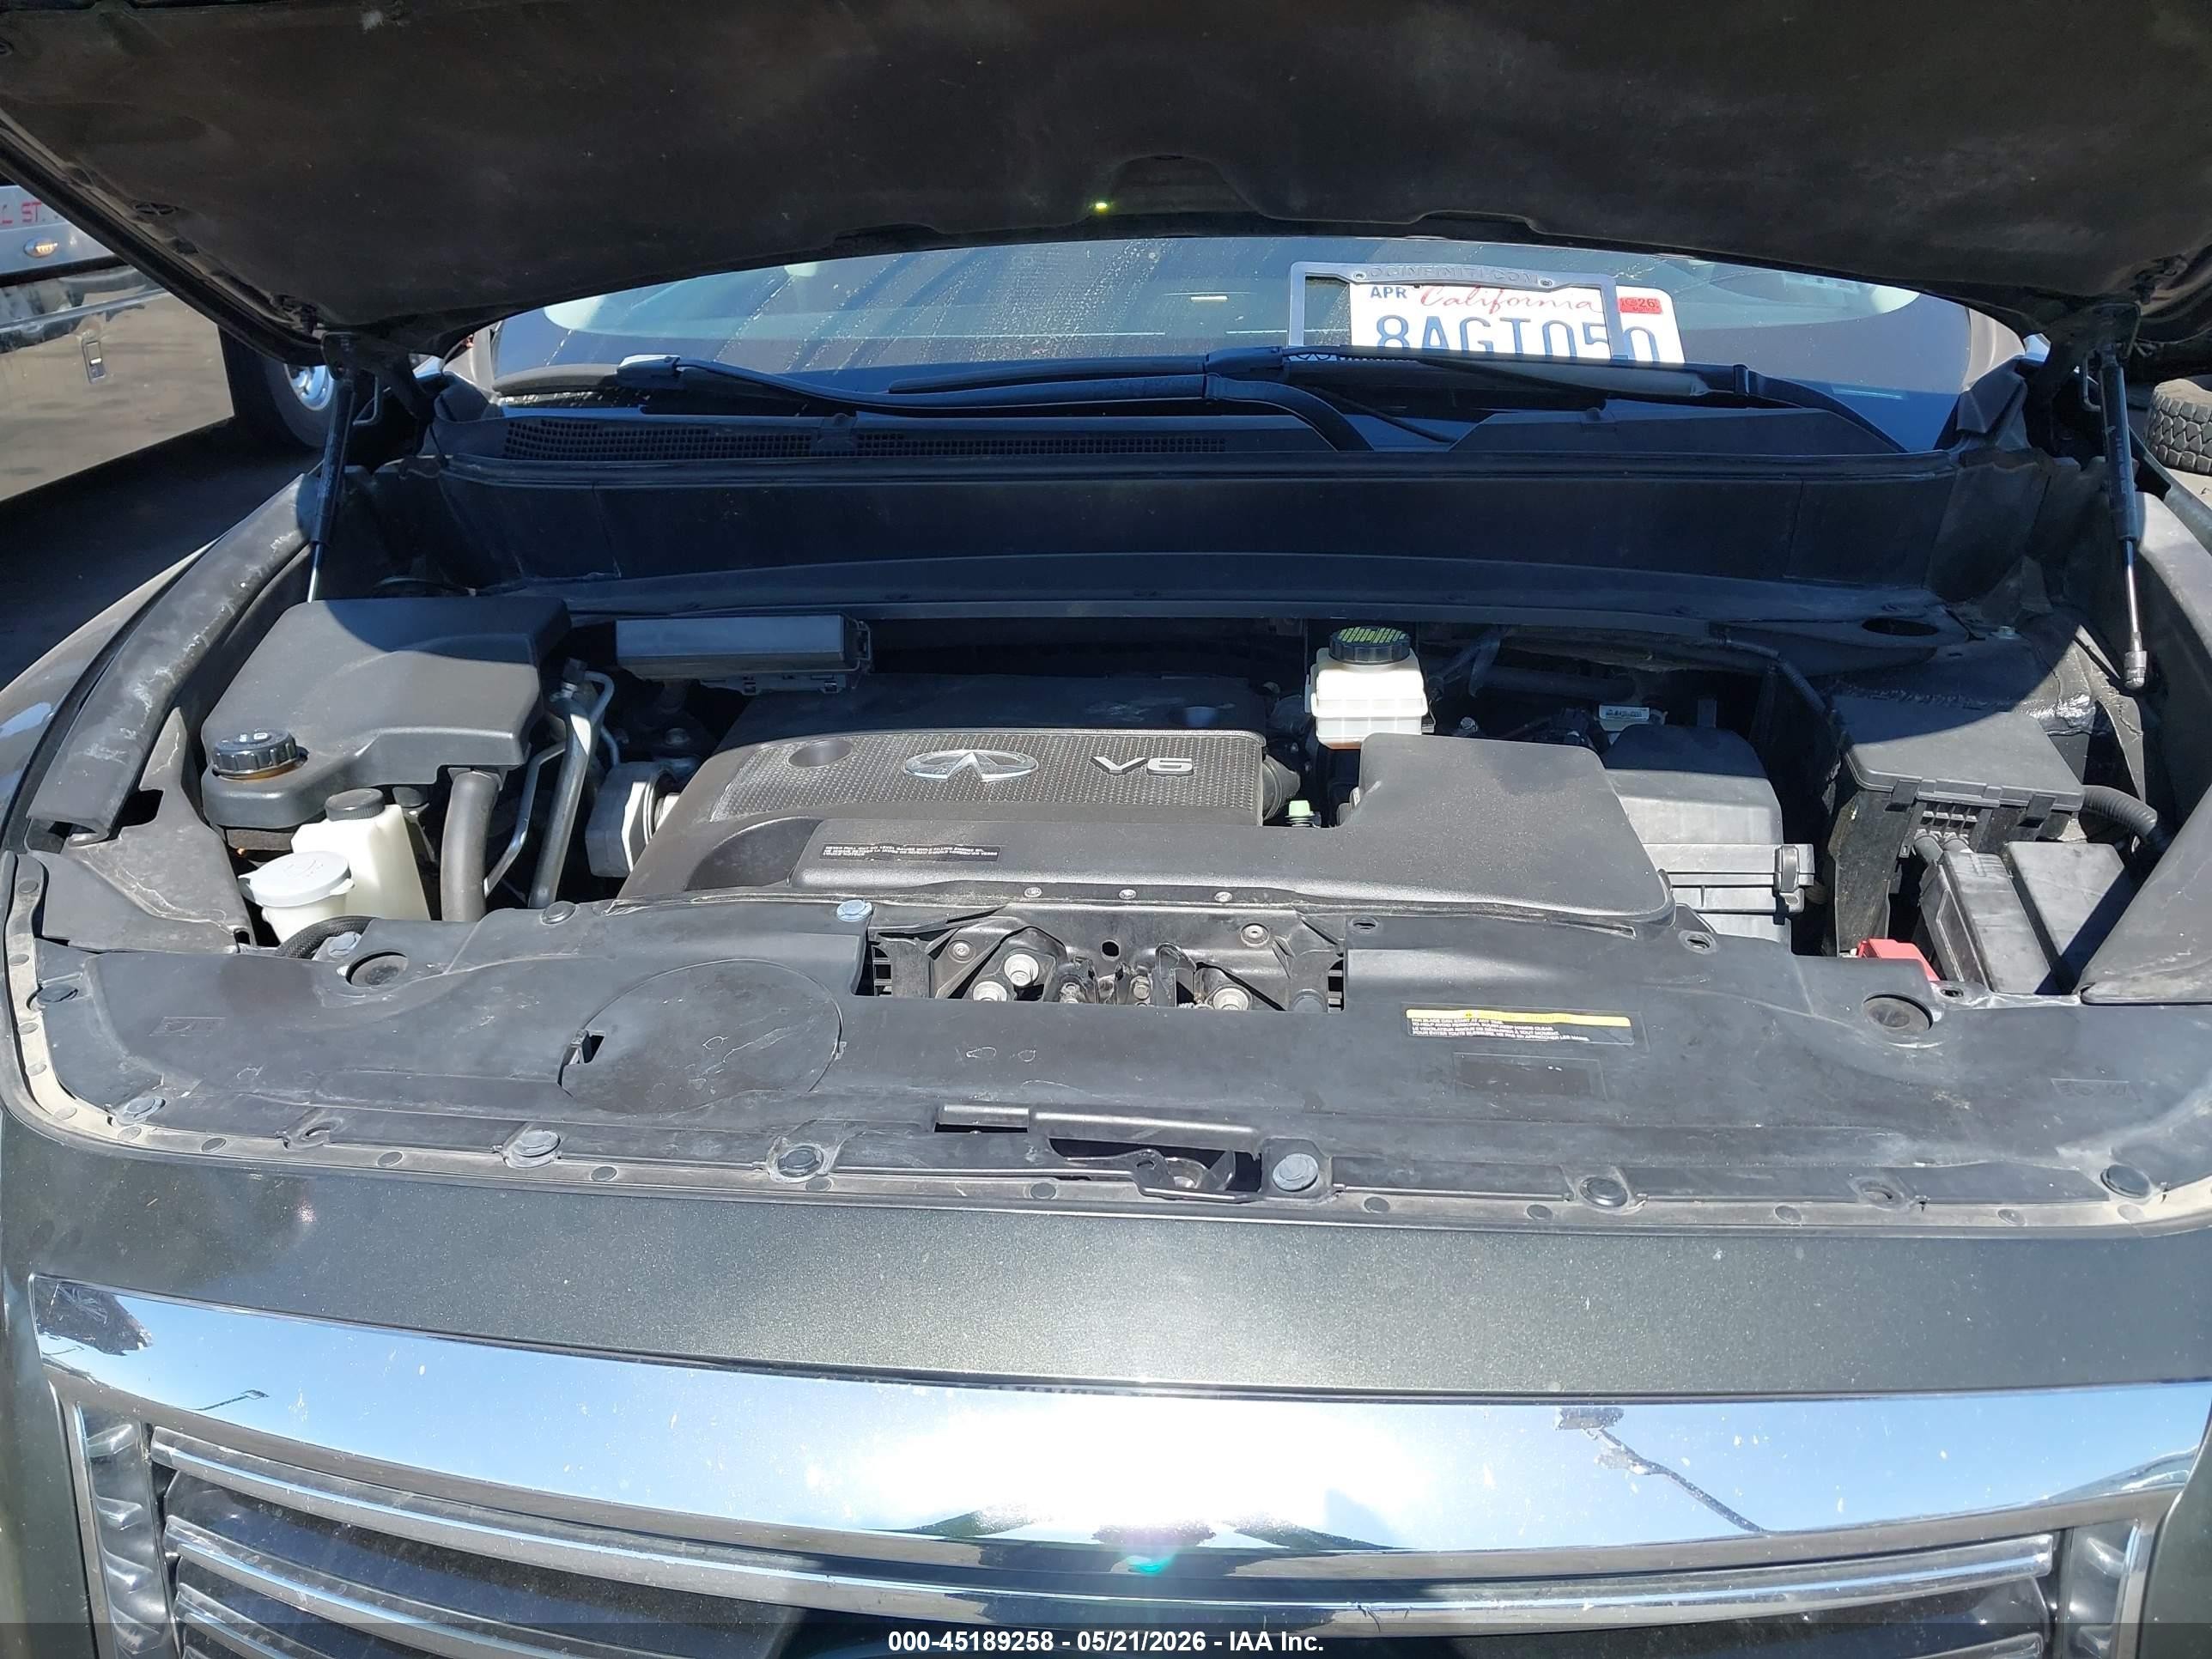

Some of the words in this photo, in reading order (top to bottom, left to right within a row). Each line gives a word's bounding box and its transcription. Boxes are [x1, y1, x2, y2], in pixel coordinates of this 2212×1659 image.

[1370, 286, 1407, 299] APR
[1420, 284, 1603, 314] California
[1638, 298, 1656, 308] 26
[1091, 756, 1194, 775] V6
